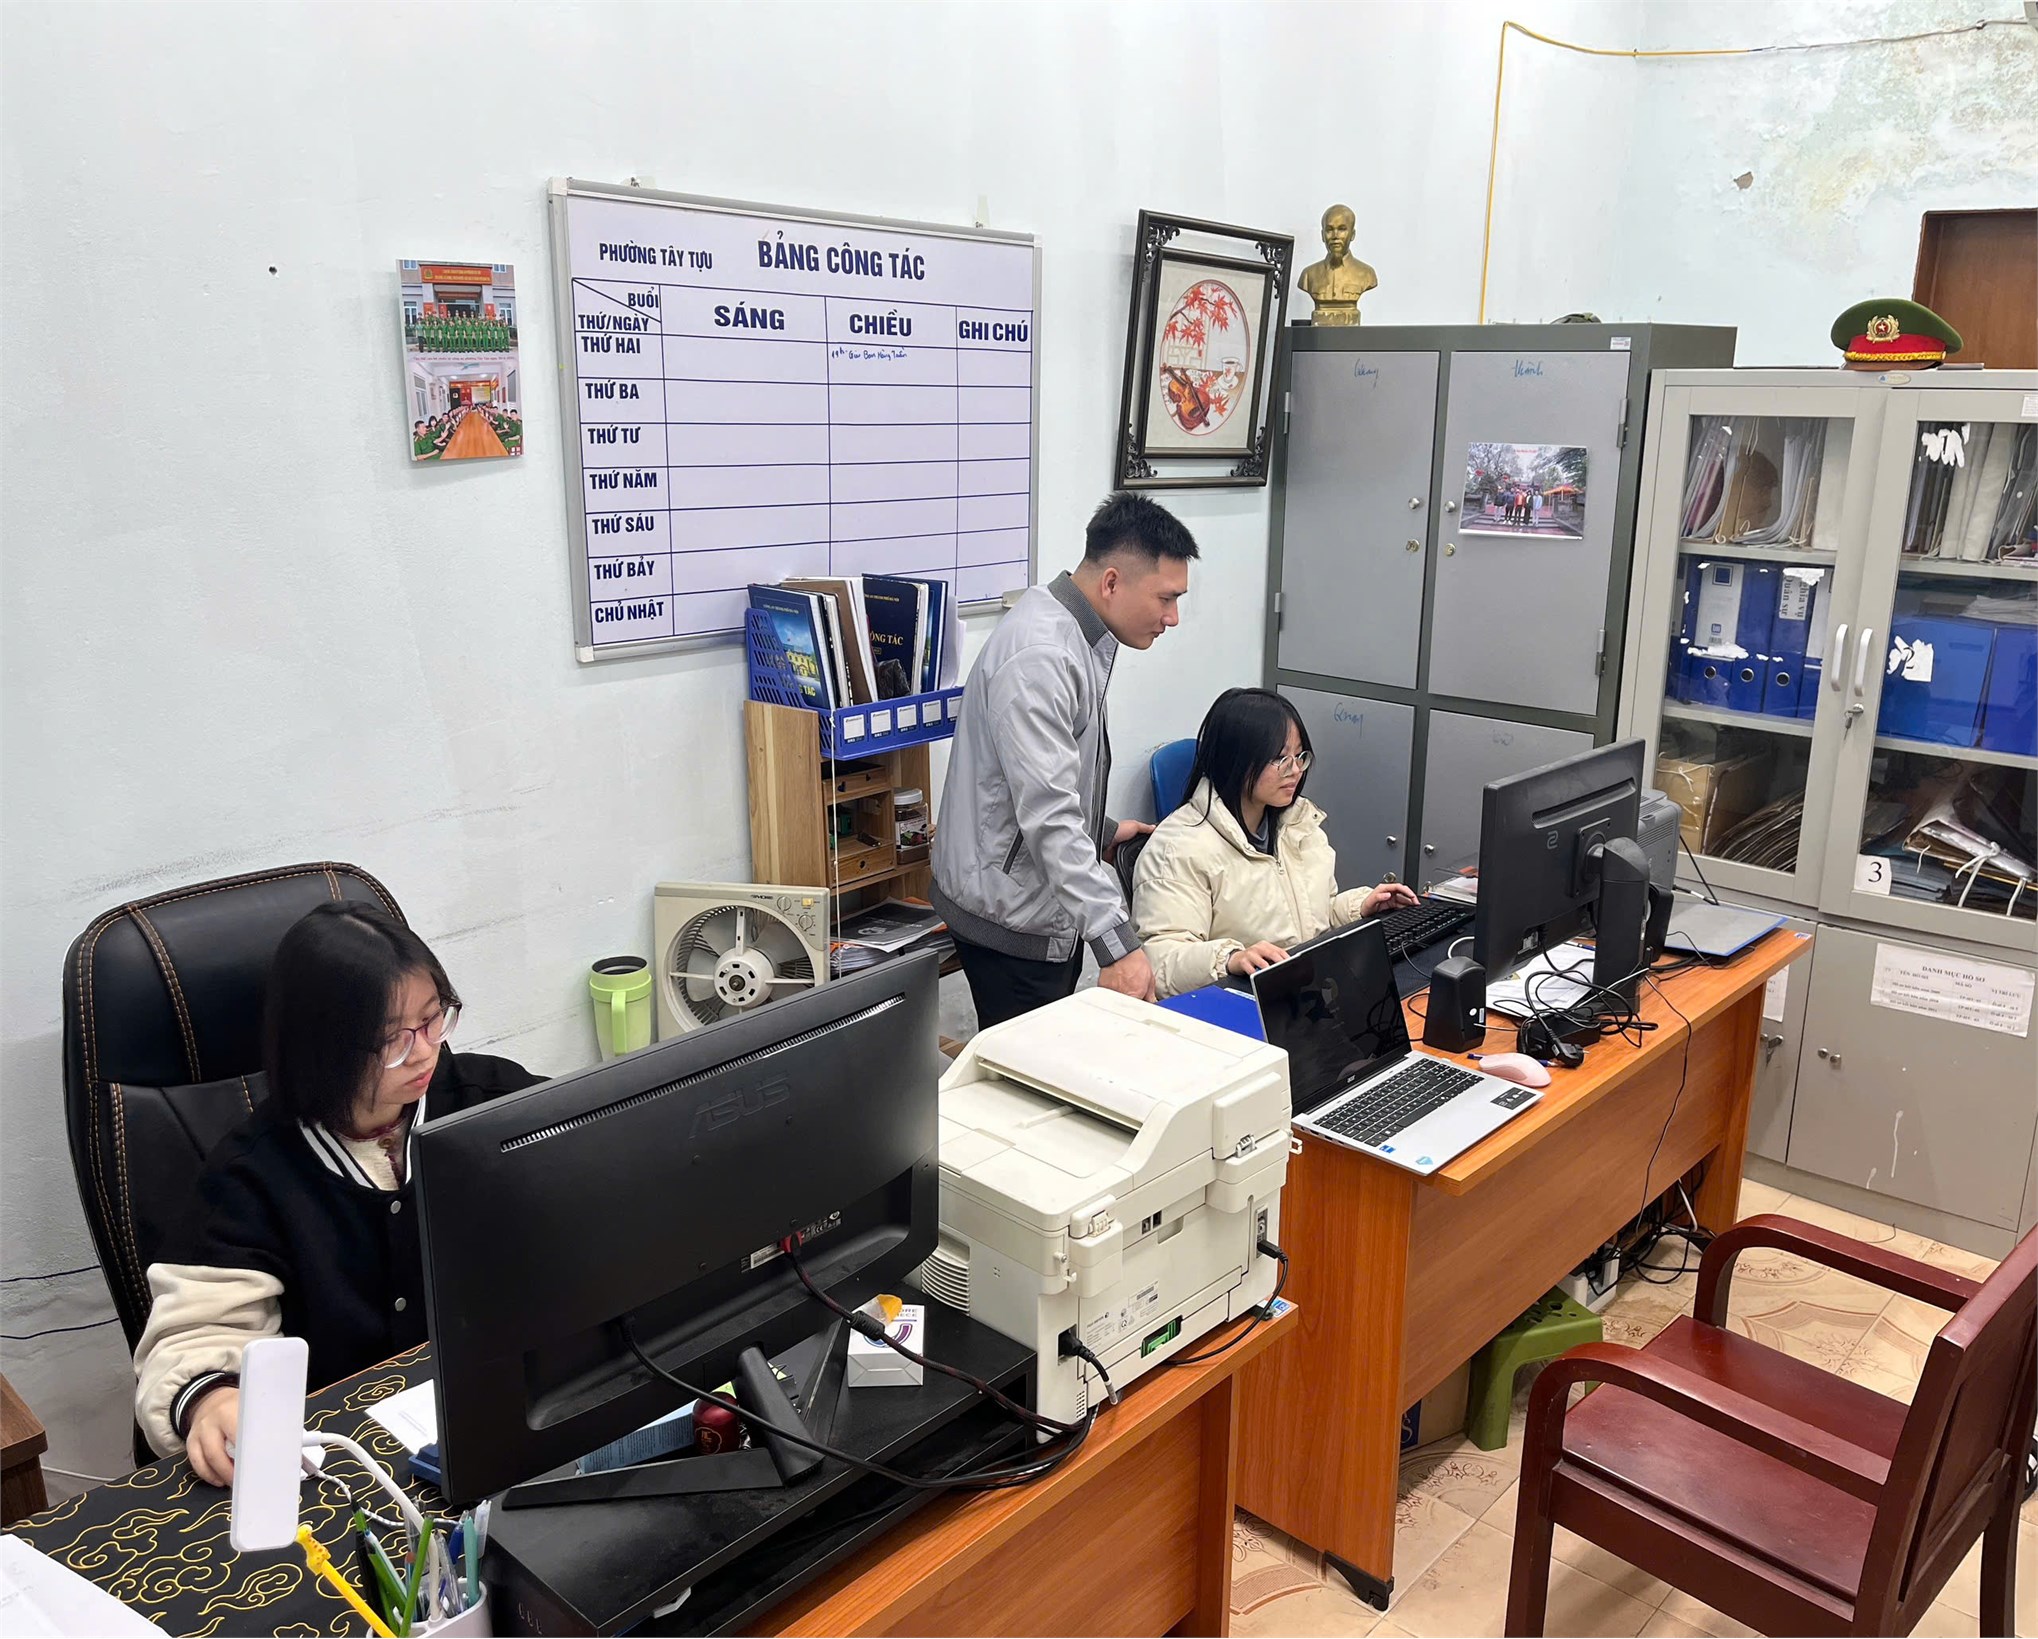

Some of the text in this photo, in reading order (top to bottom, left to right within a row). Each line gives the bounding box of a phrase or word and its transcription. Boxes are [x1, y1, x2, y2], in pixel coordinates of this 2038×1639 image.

[599, 241, 713, 270] PHƯỜNG TÂY TỰU
[758, 231, 925, 281] BẢNG CÔNG TÁC
[627, 287, 659, 310] BUỔI
[714, 303, 785, 330] SÁNG
[849, 309, 912, 337] CHIỀU
[959, 319, 1028, 342] GHI CHÚ
[581, 333, 640, 354] THỨ HAI
[585, 382, 640, 400] THỨ BA
[588, 426, 642, 444] THỨ TƯ
[589, 469, 658, 490] THỨ NĂM
[592, 513, 655, 535] THỨ SÁU
[594, 555, 655, 580] THỨ BẢY
[595, 600, 664, 624] CHỦ NHẬT
[869, 630, 886, 643] ÔNG
[1868, 861, 1882, 883] 3
[688, 1072, 791, 1140] ASUS
